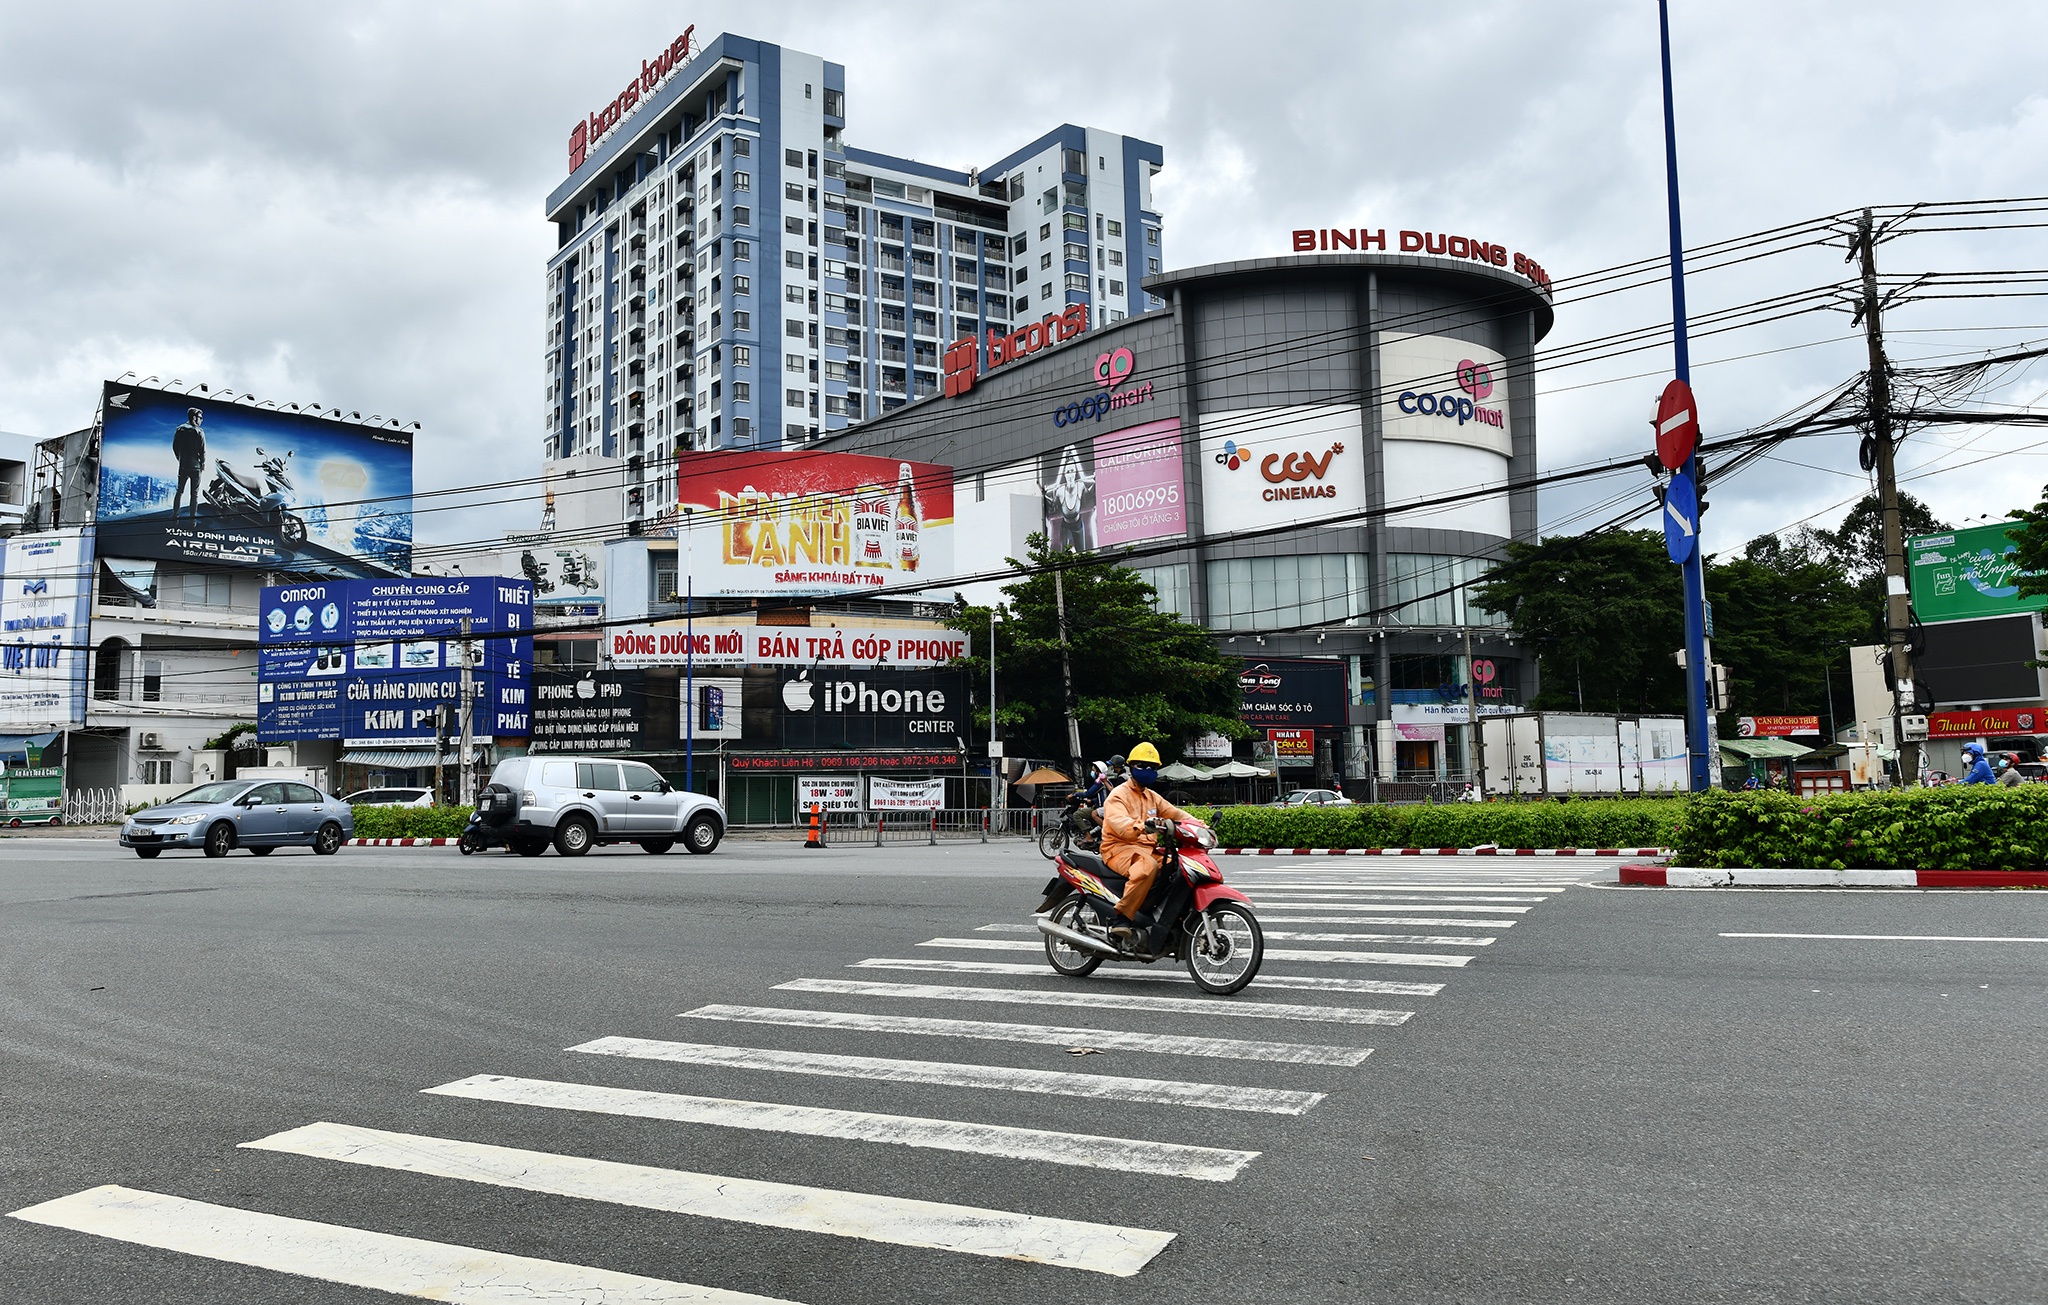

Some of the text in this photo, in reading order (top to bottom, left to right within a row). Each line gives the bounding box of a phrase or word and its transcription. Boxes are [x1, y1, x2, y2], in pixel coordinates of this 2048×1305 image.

[590, 24, 694, 145] biconsi tower
[1292, 229, 1387, 252] BINH
[1399, 230, 1507, 267] DUONG
[988, 302, 1086, 369] biconsi
[109, 402, 131, 410] HONDA
[1100, 441, 1178, 468] CALIFORNIA
[1215, 453, 1229, 465] CJ
[1260, 450, 1334, 483] CGV
[1102, 485, 1179, 516] 18006995
[1262, 485, 1337, 502] CINEMAS
[720, 485, 851, 523] LÊN MEN
[857, 517, 889, 533] BIA VIỆT
[1103, 519, 1129, 533] CHÚNG
[1129, 517, 1140, 528] TÔI
[1174, 512, 1180, 521] 3
[197, 531, 225, 541] DANH
[906, 532, 917, 542] VIỆT
[166, 538, 276, 556] AIRBLADE
[721, 521, 851, 569] LẠNH
[774, 569, 807, 583] SẢNG
[1936, 572, 1950, 580] fun
[280, 586, 326, 603] OMRON
[372, 582, 470, 596] CHUYÊN CUNG CẤP
[498, 584, 530, 605] THIẾT
[357, 599, 371, 607] THIẾT
[508, 613, 520, 631] BỊ
[510, 638, 518, 654] Y
[614, 629, 656, 655] ĐÔNG
[714, 629, 743, 654] MỚI
[758, 630, 965, 661] BÁN TRẢ GÓP iPHONE
[280, 689, 338, 702] KIM VĨNH PHÁT
[347, 676, 438, 703] CỬA HÀNG DỤNG
[501, 687, 525, 705] KIM
[538, 683, 622, 700] IPHONE IPAD
[586, 706, 597, 718] CÁC
[1278, 701, 1293, 712] SÓC
[1295, 702, 1302, 712] Ô
[1303, 702, 1313, 712] TÔ
[1424, 706, 1440, 714] Hân
[1441, 706, 1458, 714] hoan
[364, 709, 404, 730] KIM
[497, 711, 528, 730] PHÁT
[909, 720, 955, 733] CENTER
[1936, 716, 2011, 732] Thanh Vân
[732, 757, 750, 769] Quý
[752, 758, 779, 768] Khách
[782, 758, 801, 767] Liên
[802, 758, 814, 769] Hệ
[880, 757, 900, 768] hoặc
[902, 755, 957, 766] 0972.346.346
[810, 788, 853, 798] 18W 30W
